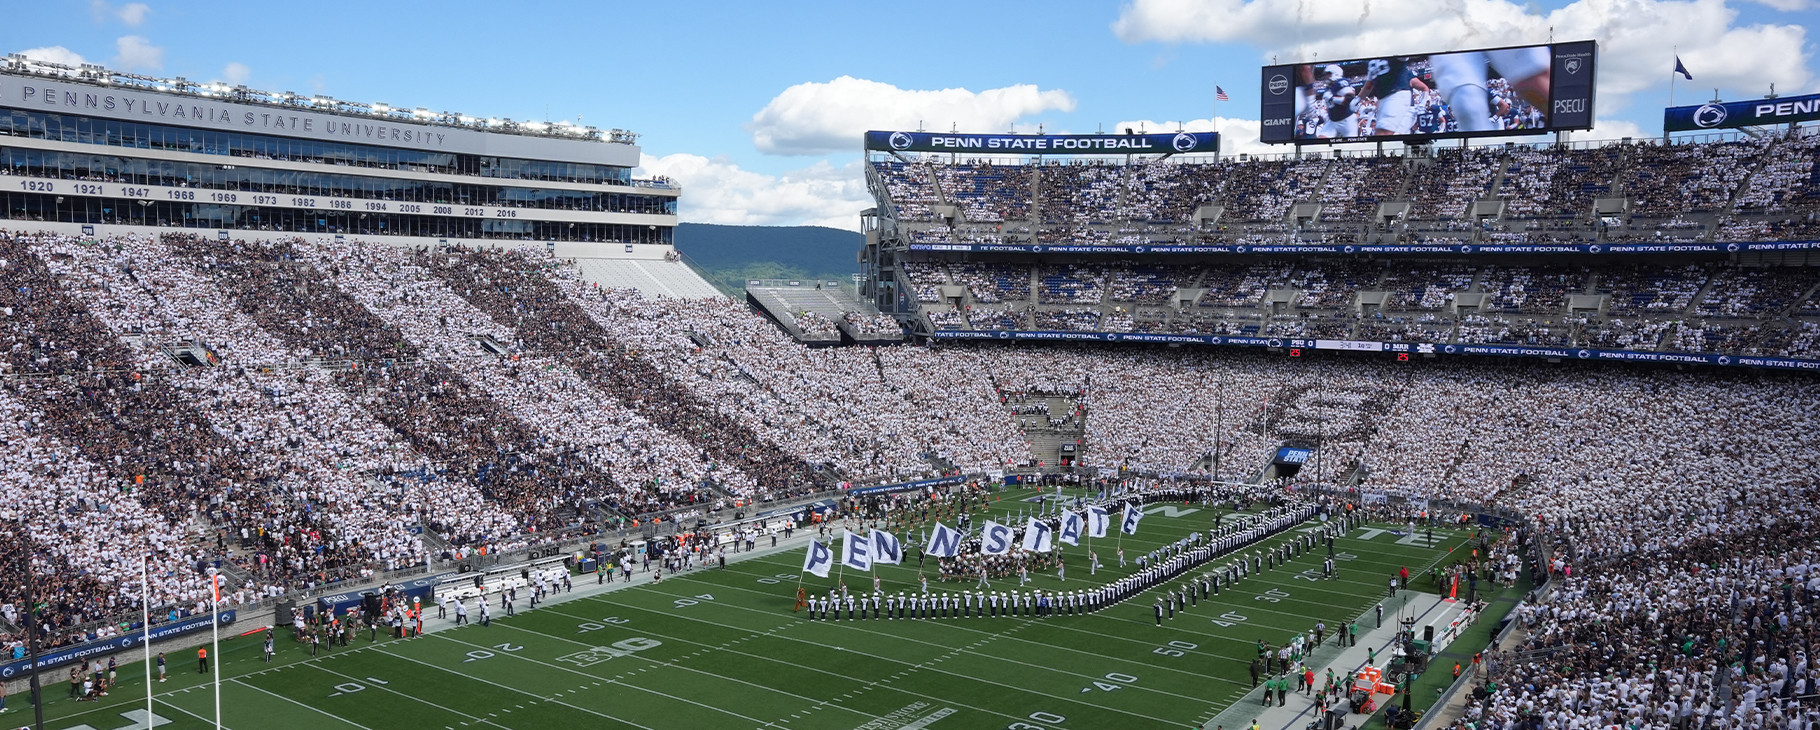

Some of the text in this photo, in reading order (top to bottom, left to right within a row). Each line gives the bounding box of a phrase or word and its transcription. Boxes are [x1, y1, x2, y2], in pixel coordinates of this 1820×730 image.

[1554, 98, 1585, 114] PSECU
[23, 86, 446, 145] PENNSYLVANIA STATE UNIVERSITY
[1264, 118, 1292, 126] GIANT
[1420, 114, 1434, 127] 67
[932, 137, 1152, 149] PENN STATE FOOTBALL
[20, 180, 516, 218] 1920 1921 1947 1968 1969 1973 1982 1986 1994 2005 2008 2012 2016
[757, 573, 799, 584] 50
[1255, 588, 1290, 602] 30
[578, 616, 630, 632] 30
[1212, 612, 1248, 627] 40
[159, 628, 180, 636] STATE
[465, 642, 524, 660] 20
[1153, 640, 1198, 657] 50
[22, 644, 115, 671] PEN STATE FOOTBALL
[1093, 672, 1138, 692] 40
